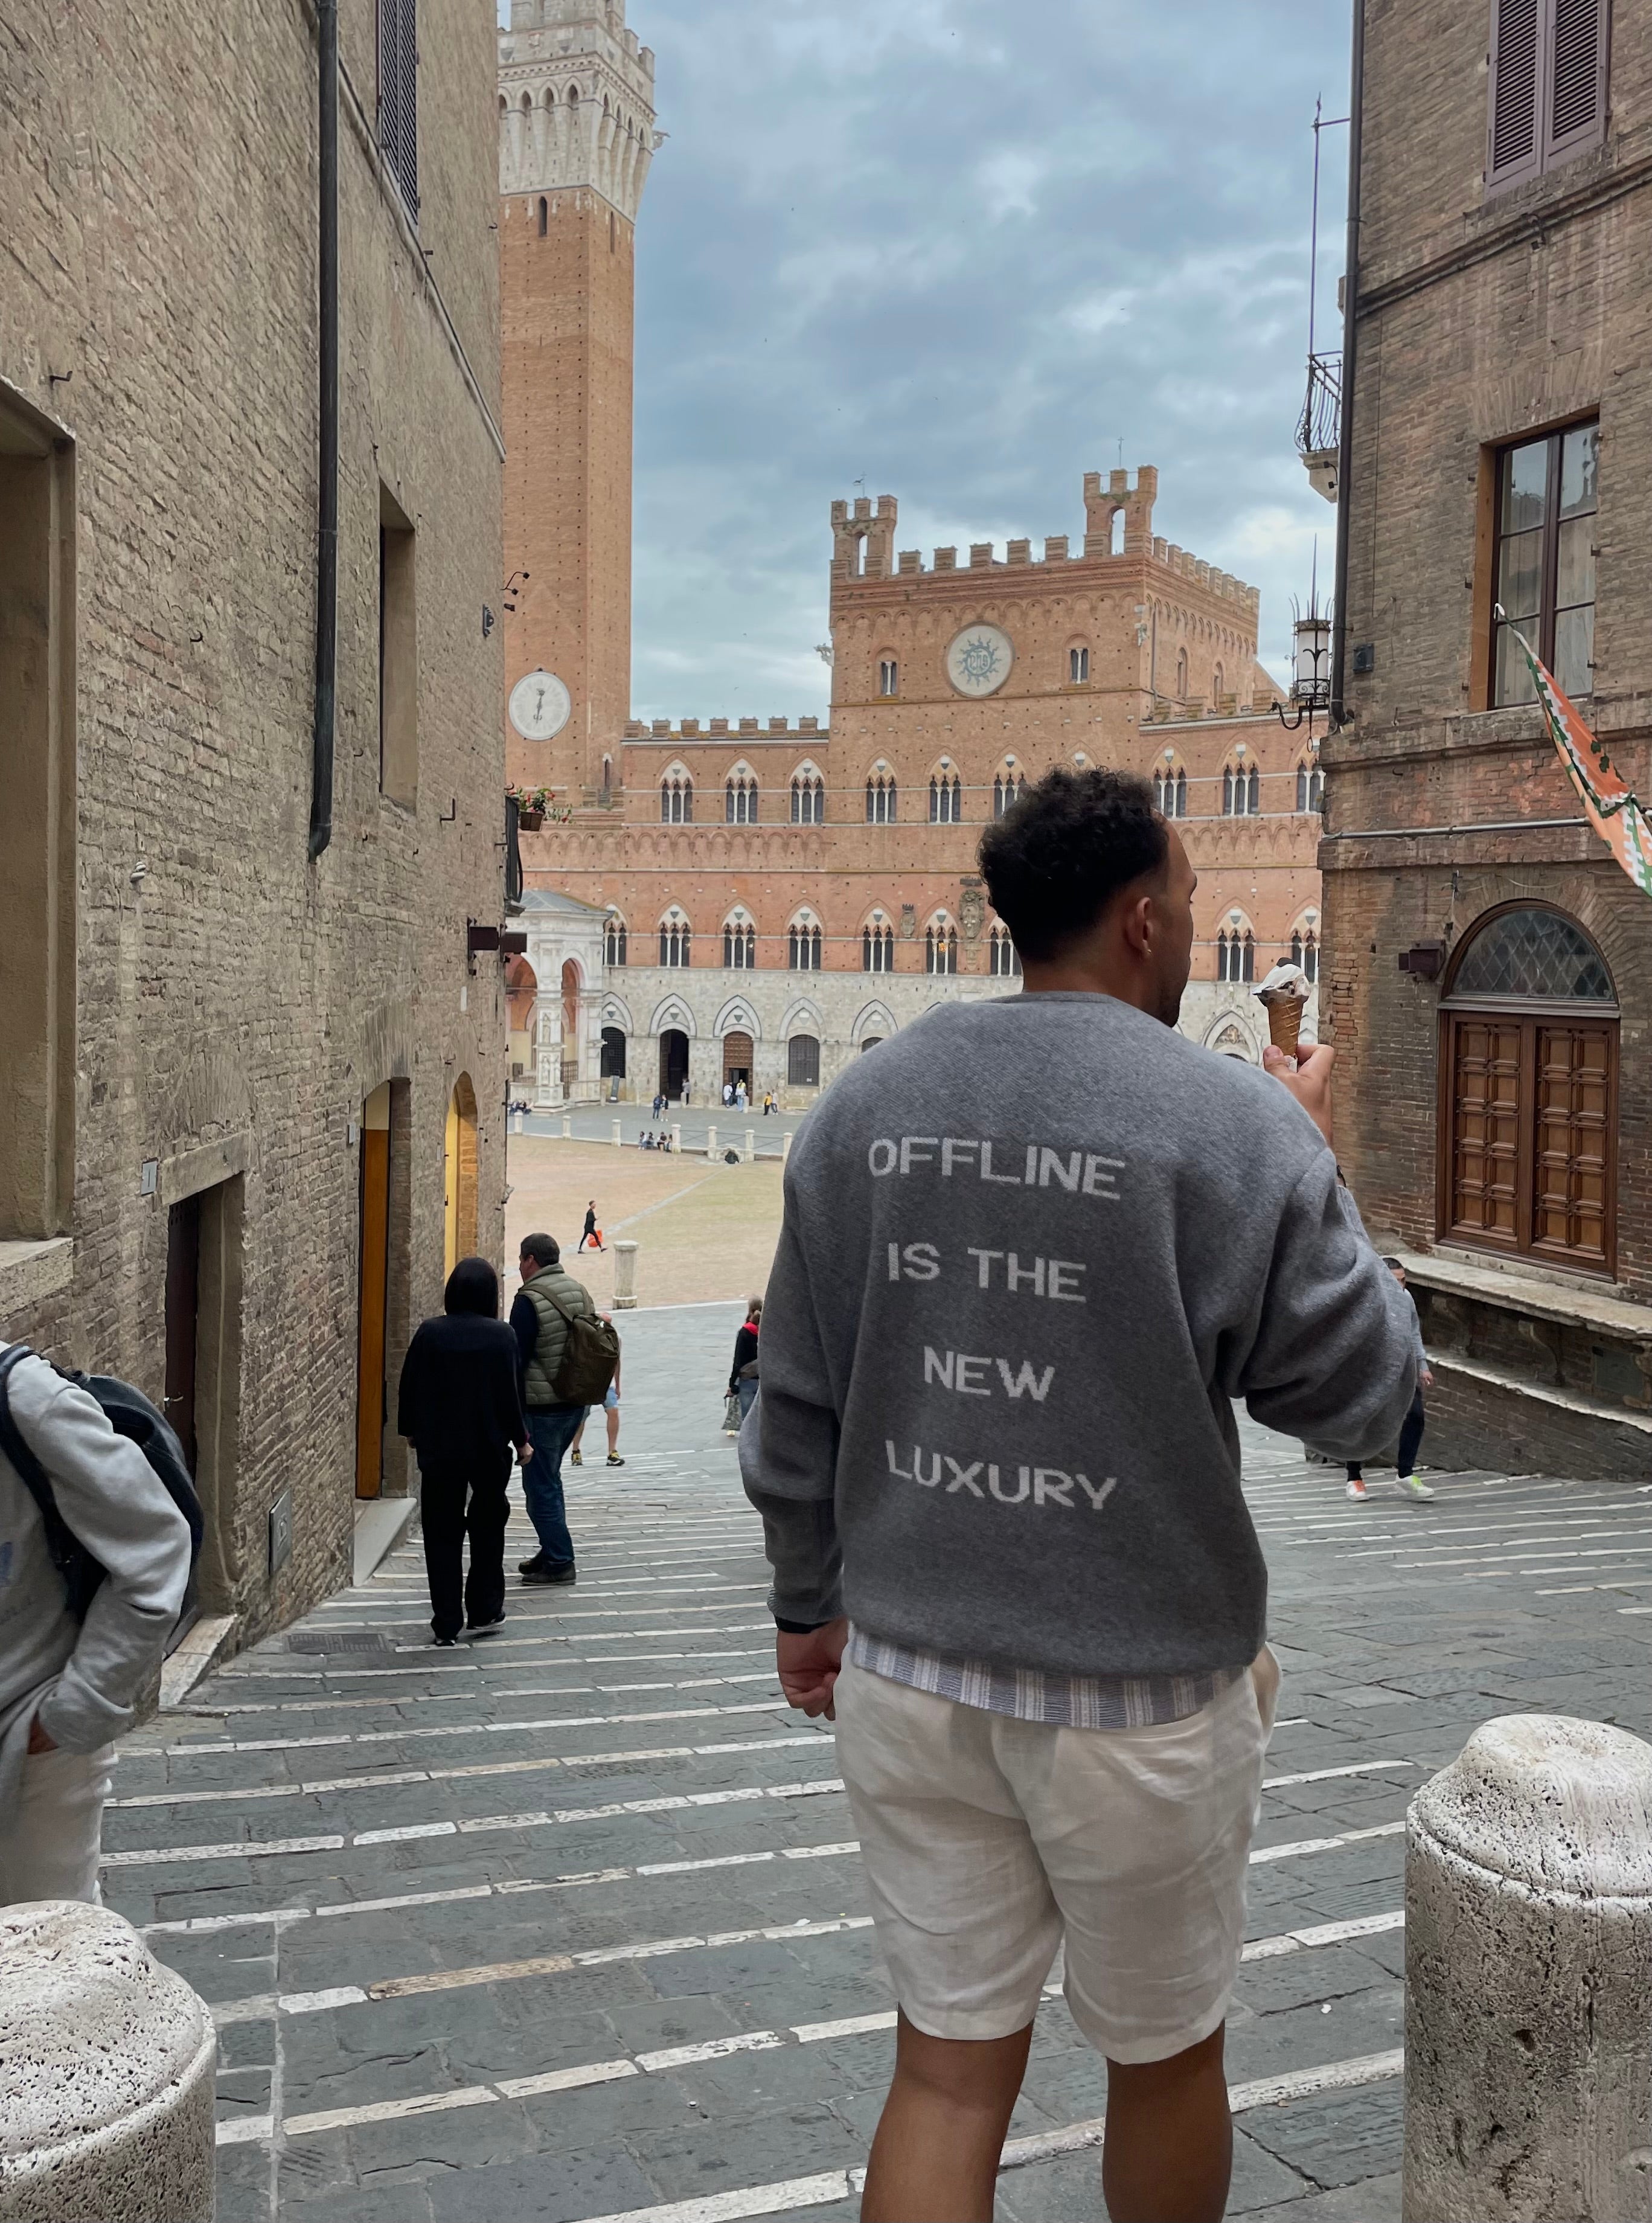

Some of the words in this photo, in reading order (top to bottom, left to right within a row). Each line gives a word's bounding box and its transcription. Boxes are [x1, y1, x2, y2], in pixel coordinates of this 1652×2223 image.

[869, 1137, 1125, 1199] OFFLINE
[888, 1242, 940, 1281] IS
[967, 1247, 1086, 1303] THE
[924, 1346, 1055, 1402] NEW
[885, 1440, 1117, 1510] LUXURY
